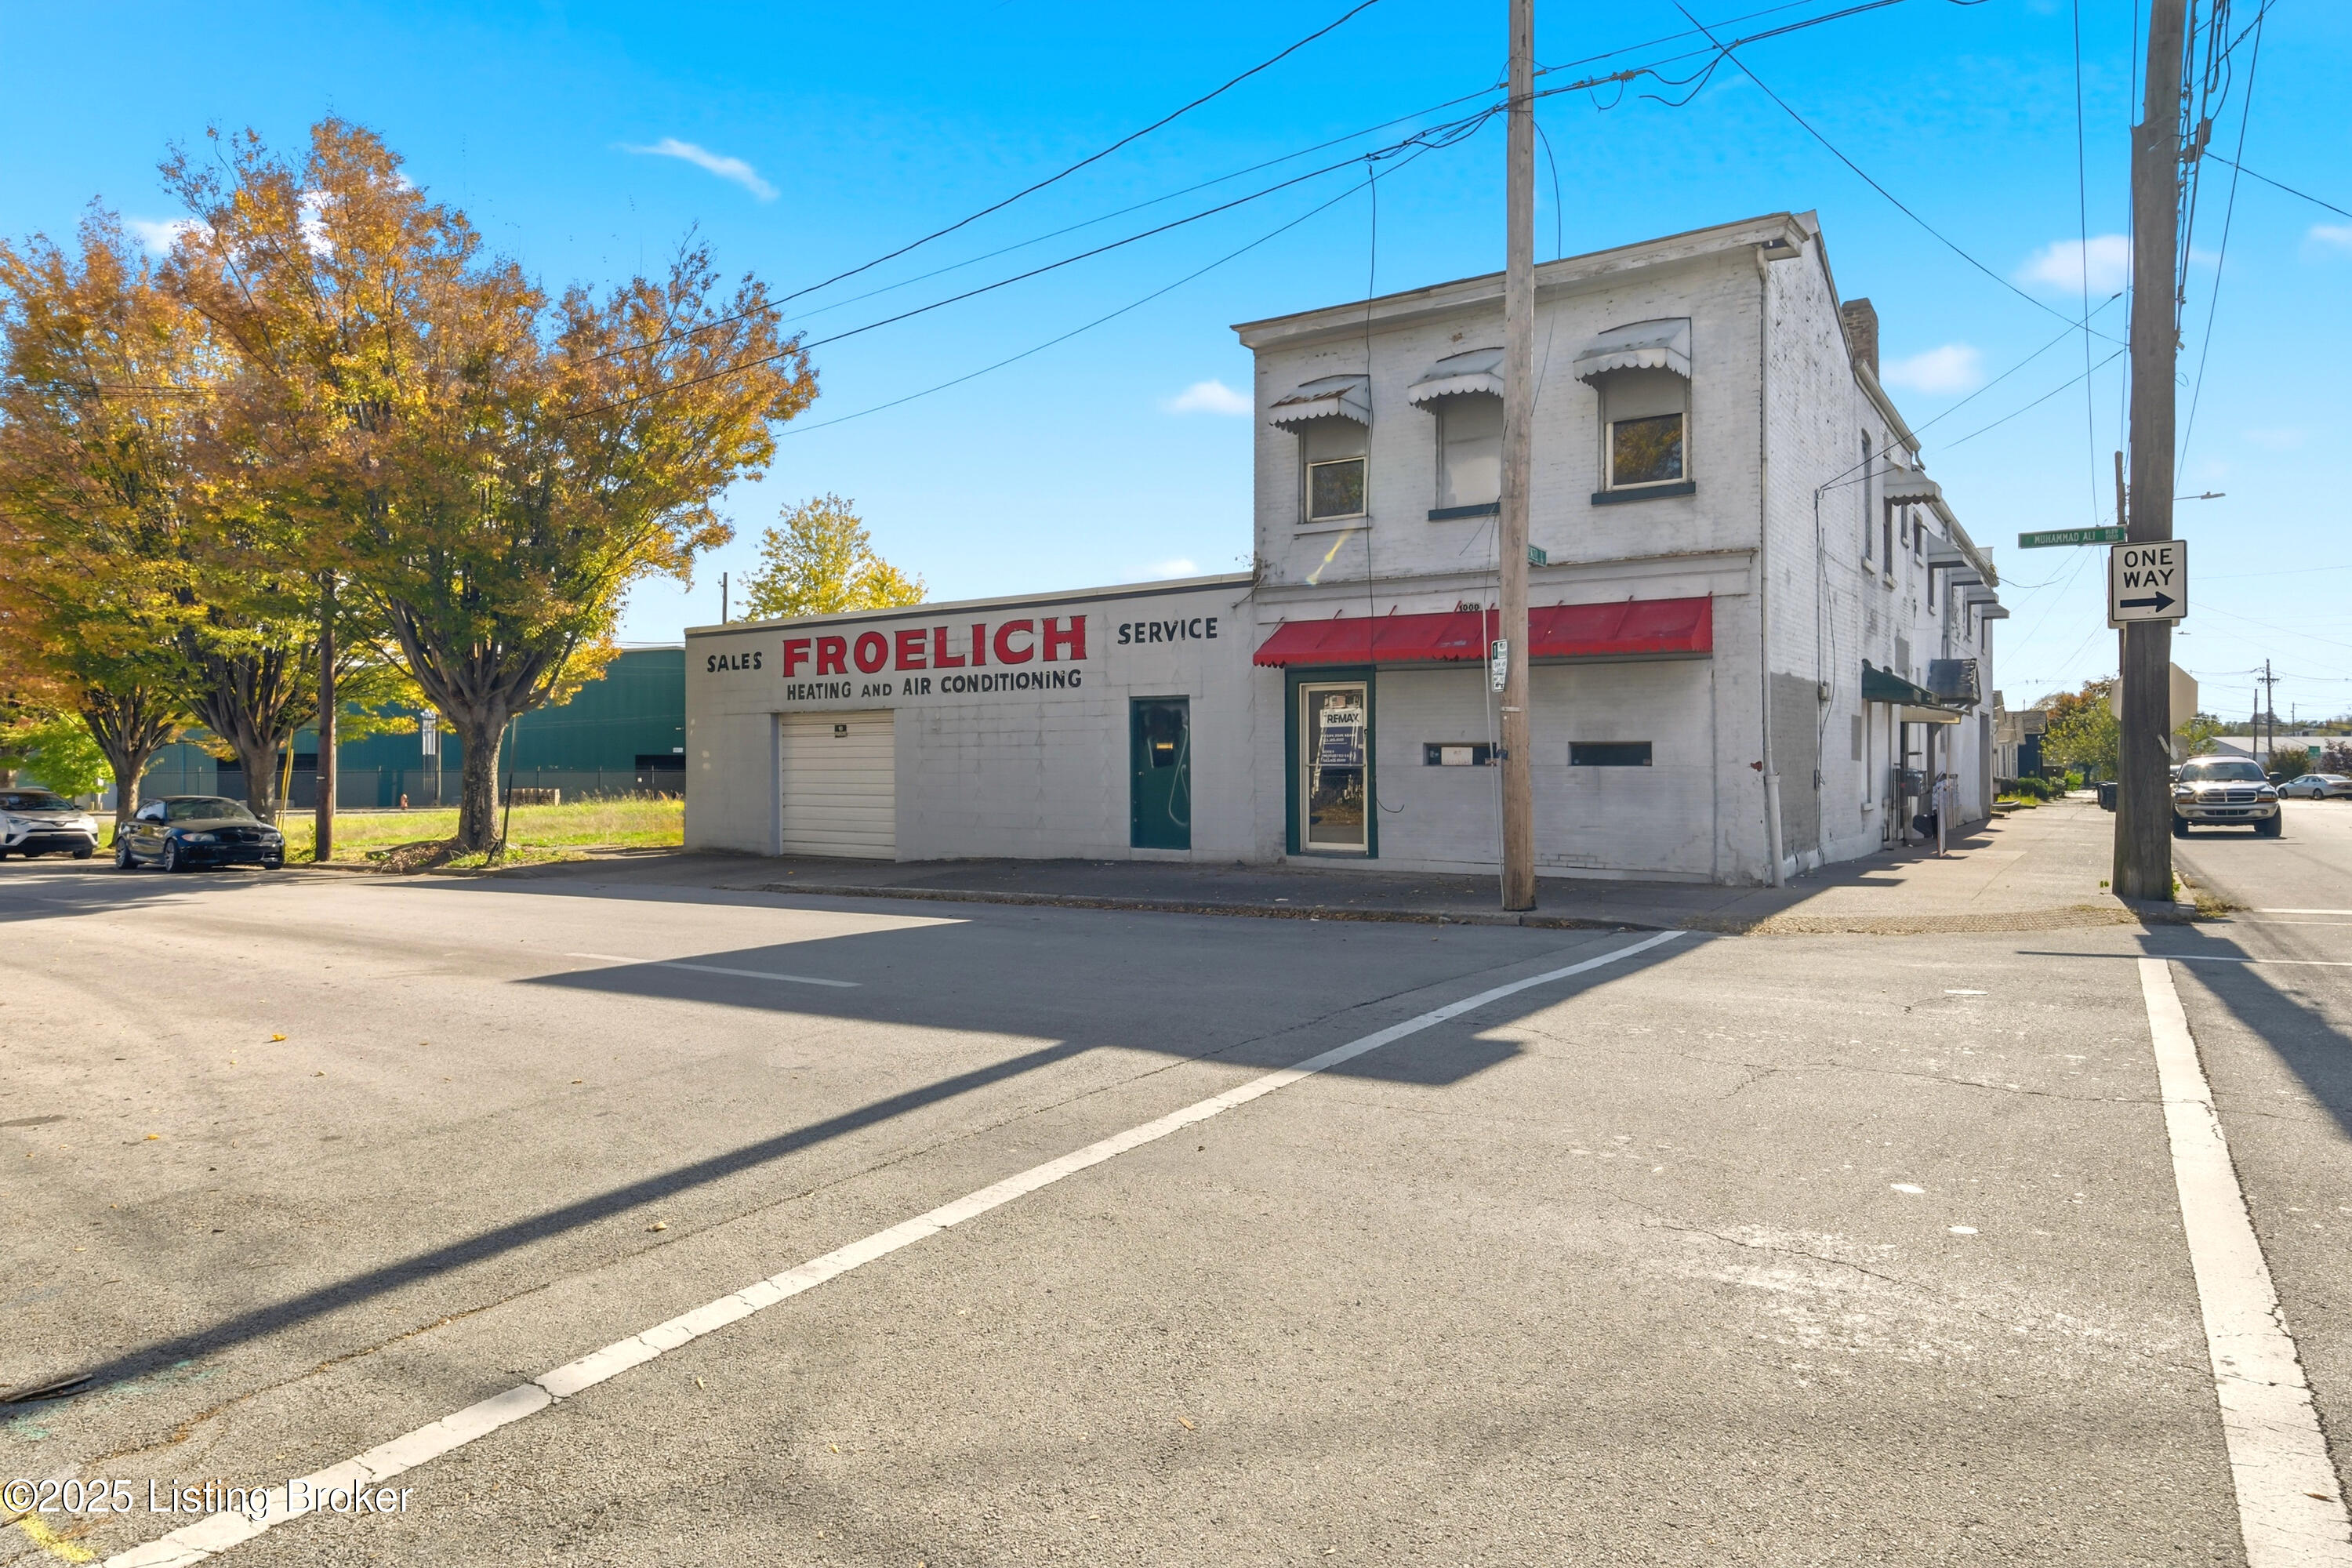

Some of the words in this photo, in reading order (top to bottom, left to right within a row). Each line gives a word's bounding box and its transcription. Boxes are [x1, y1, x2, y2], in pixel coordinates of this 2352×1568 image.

[2034, 532, 2079, 544] MUHAMMAD
[2082, 531, 2096, 541] ALI
[2124, 547, 2173, 568] ONE
[2123, 568, 2174, 588] WAY
[1117, 617, 1218, 644] SERVICE
[782, 615, 1087, 677] FROELICH
[707, 652, 762, 673] SALES
[786, 681, 851, 700] HEATING
[861, 683, 892, 698] AND
[902, 677, 931, 695] AIR
[941, 669, 1082, 694] CONDITIONING
